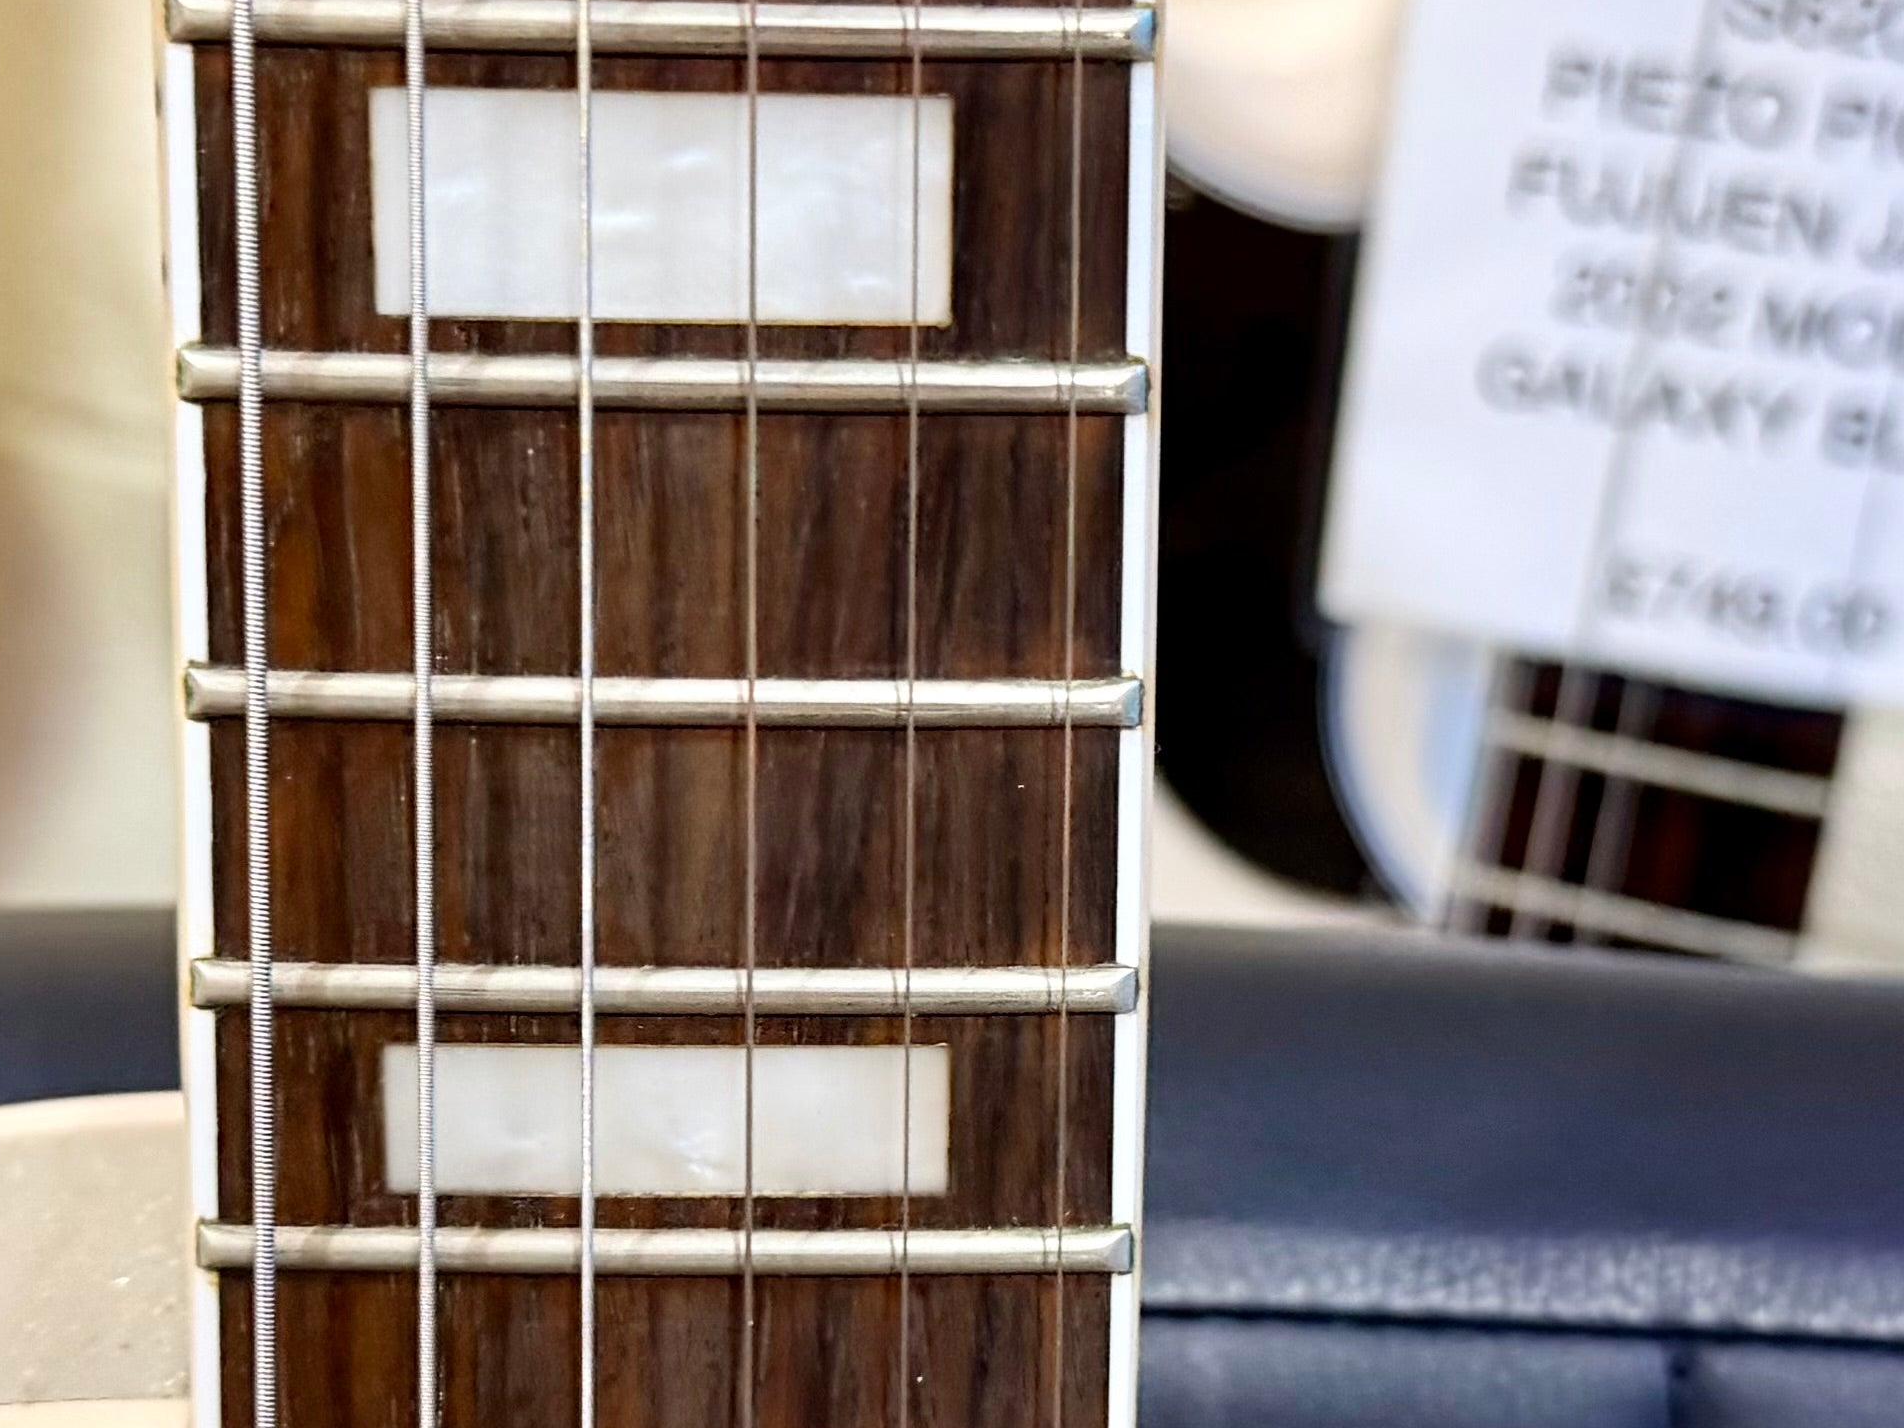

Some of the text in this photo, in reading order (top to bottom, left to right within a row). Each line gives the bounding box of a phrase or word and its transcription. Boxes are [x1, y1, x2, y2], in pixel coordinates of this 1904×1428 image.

[1542, 43, 1797, 151] PIEZO
[1554, 258, 1729, 346] 2002
[1476, 336, 1805, 455] GALAXY
